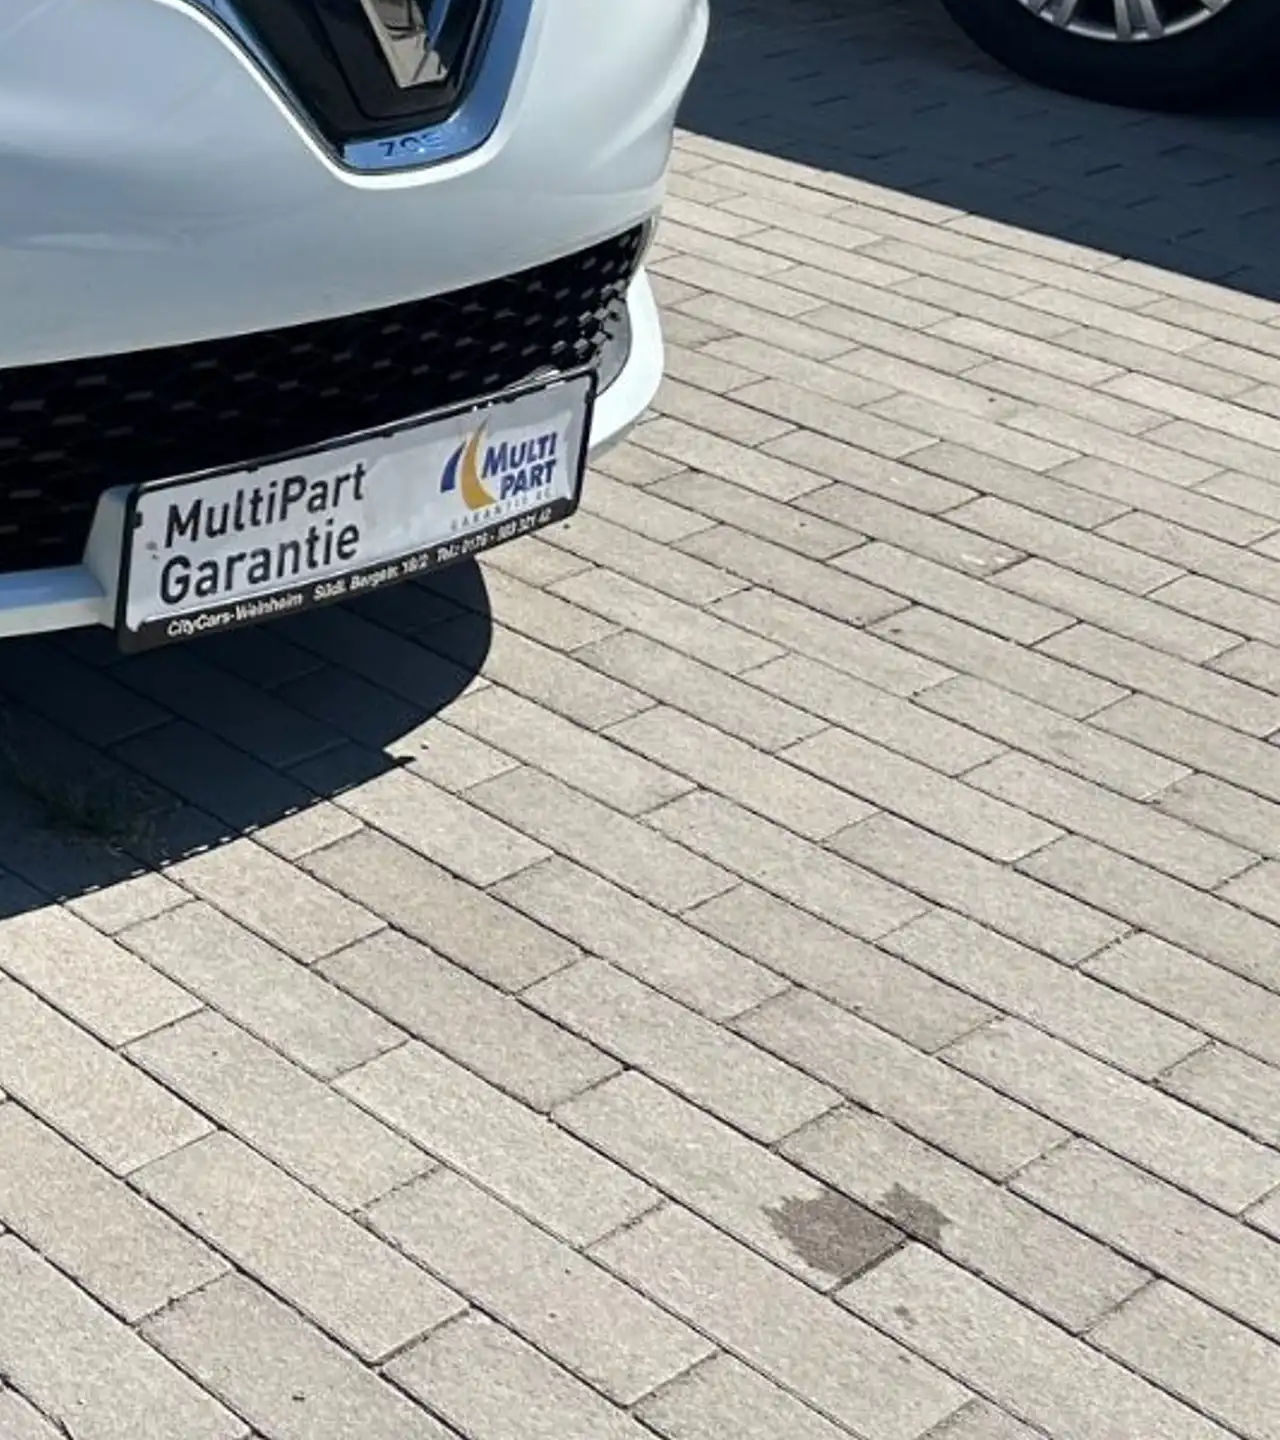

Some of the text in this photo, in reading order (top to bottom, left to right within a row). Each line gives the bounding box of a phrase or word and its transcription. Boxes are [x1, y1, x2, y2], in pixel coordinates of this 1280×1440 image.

[481, 432, 557, 479] MULTI
[500, 458, 556, 500] PART
[164, 463, 366, 548] MultiPart
[160, 517, 360, 605] Garantie
